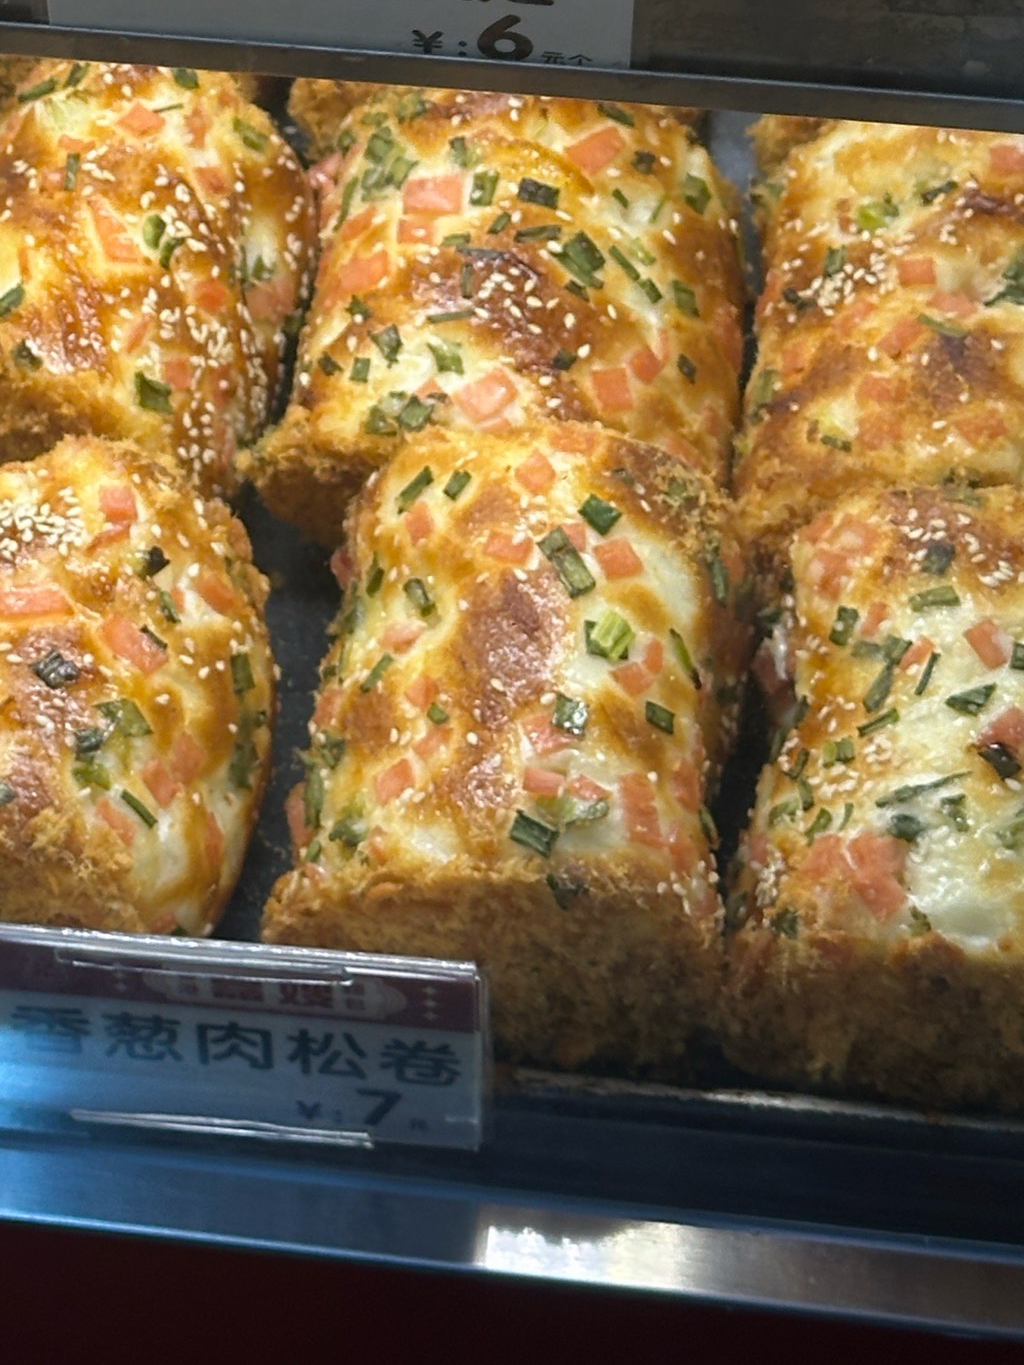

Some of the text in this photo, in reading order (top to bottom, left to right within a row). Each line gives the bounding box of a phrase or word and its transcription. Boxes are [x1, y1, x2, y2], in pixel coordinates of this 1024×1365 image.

[11, 1005, 461, 1087] 香葱肉松卷
